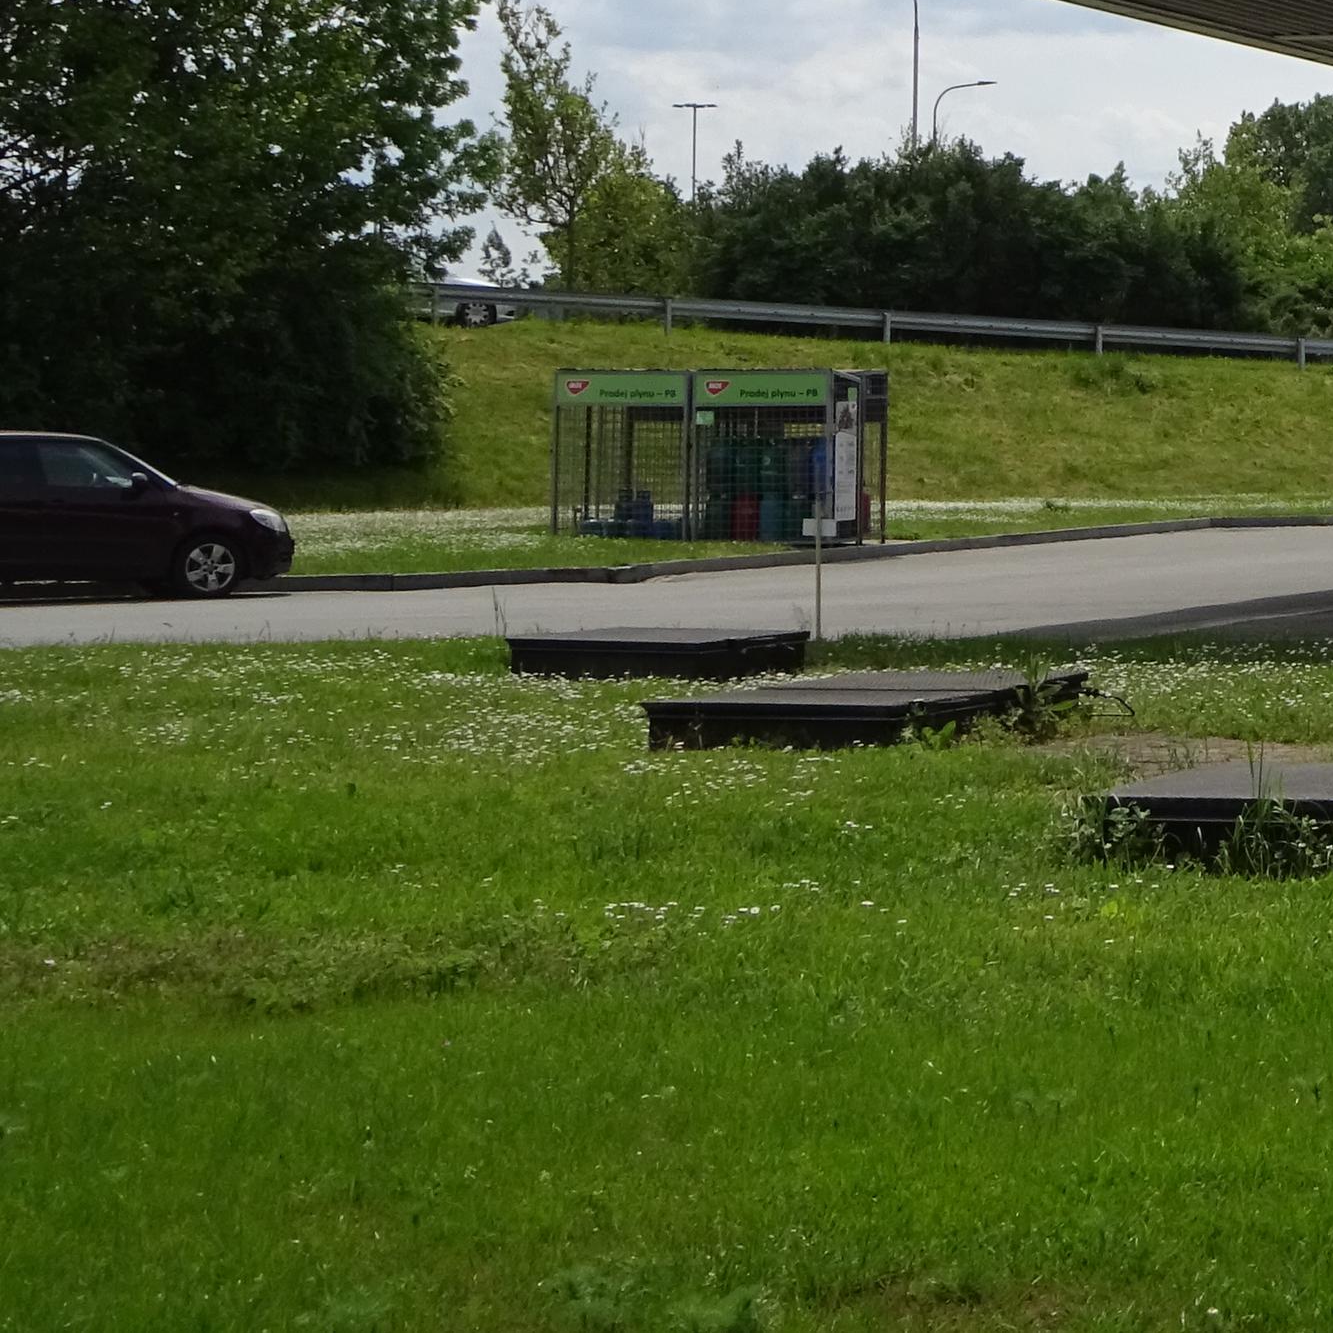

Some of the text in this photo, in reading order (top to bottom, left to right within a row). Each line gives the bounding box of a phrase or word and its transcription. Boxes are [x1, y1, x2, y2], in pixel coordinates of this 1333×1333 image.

[599, 389, 628, 399] Prodej
[629, 389, 655, 399] plynu
[740, 389, 769, 399] Prodej
[770, 389, 796, 399] plynu
[806, 389, 818, 398] PB
